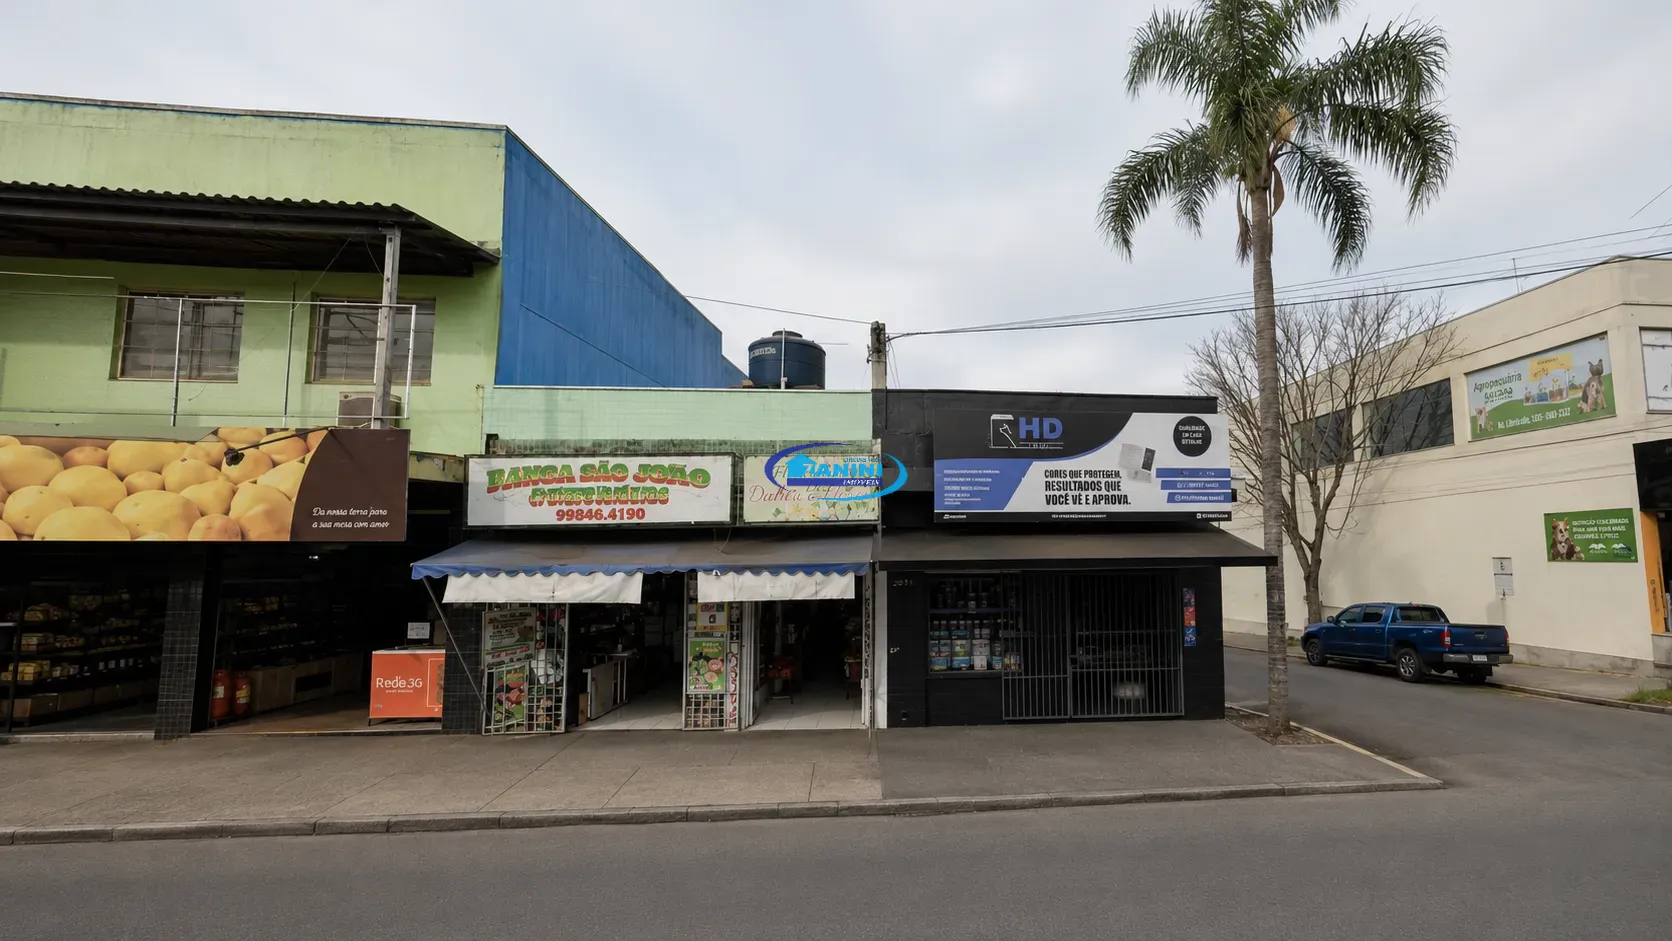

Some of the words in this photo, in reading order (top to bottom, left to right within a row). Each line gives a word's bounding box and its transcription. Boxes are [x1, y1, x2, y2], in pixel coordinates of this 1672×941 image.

[1018, 417, 1063, 439] HD
[579, 460, 629, 483] SÃO
[632, 463, 711, 490] JOÃO
[1044, 469, 1068, 479] CORES
[1068, 469, 1082, 479] QUE
[1044, 480, 1103, 492] RESULTADOS
[1104, 480, 1122, 493] QUE
[1085, 494, 1090, 505] E
[1092, 494, 1131, 505] APROVA.
[312, 507, 325, 516] Da
[349, 507, 368, 516] terra
[556, 507, 646, 522] 99846.4190
[376, 676, 406, 688] Rede
